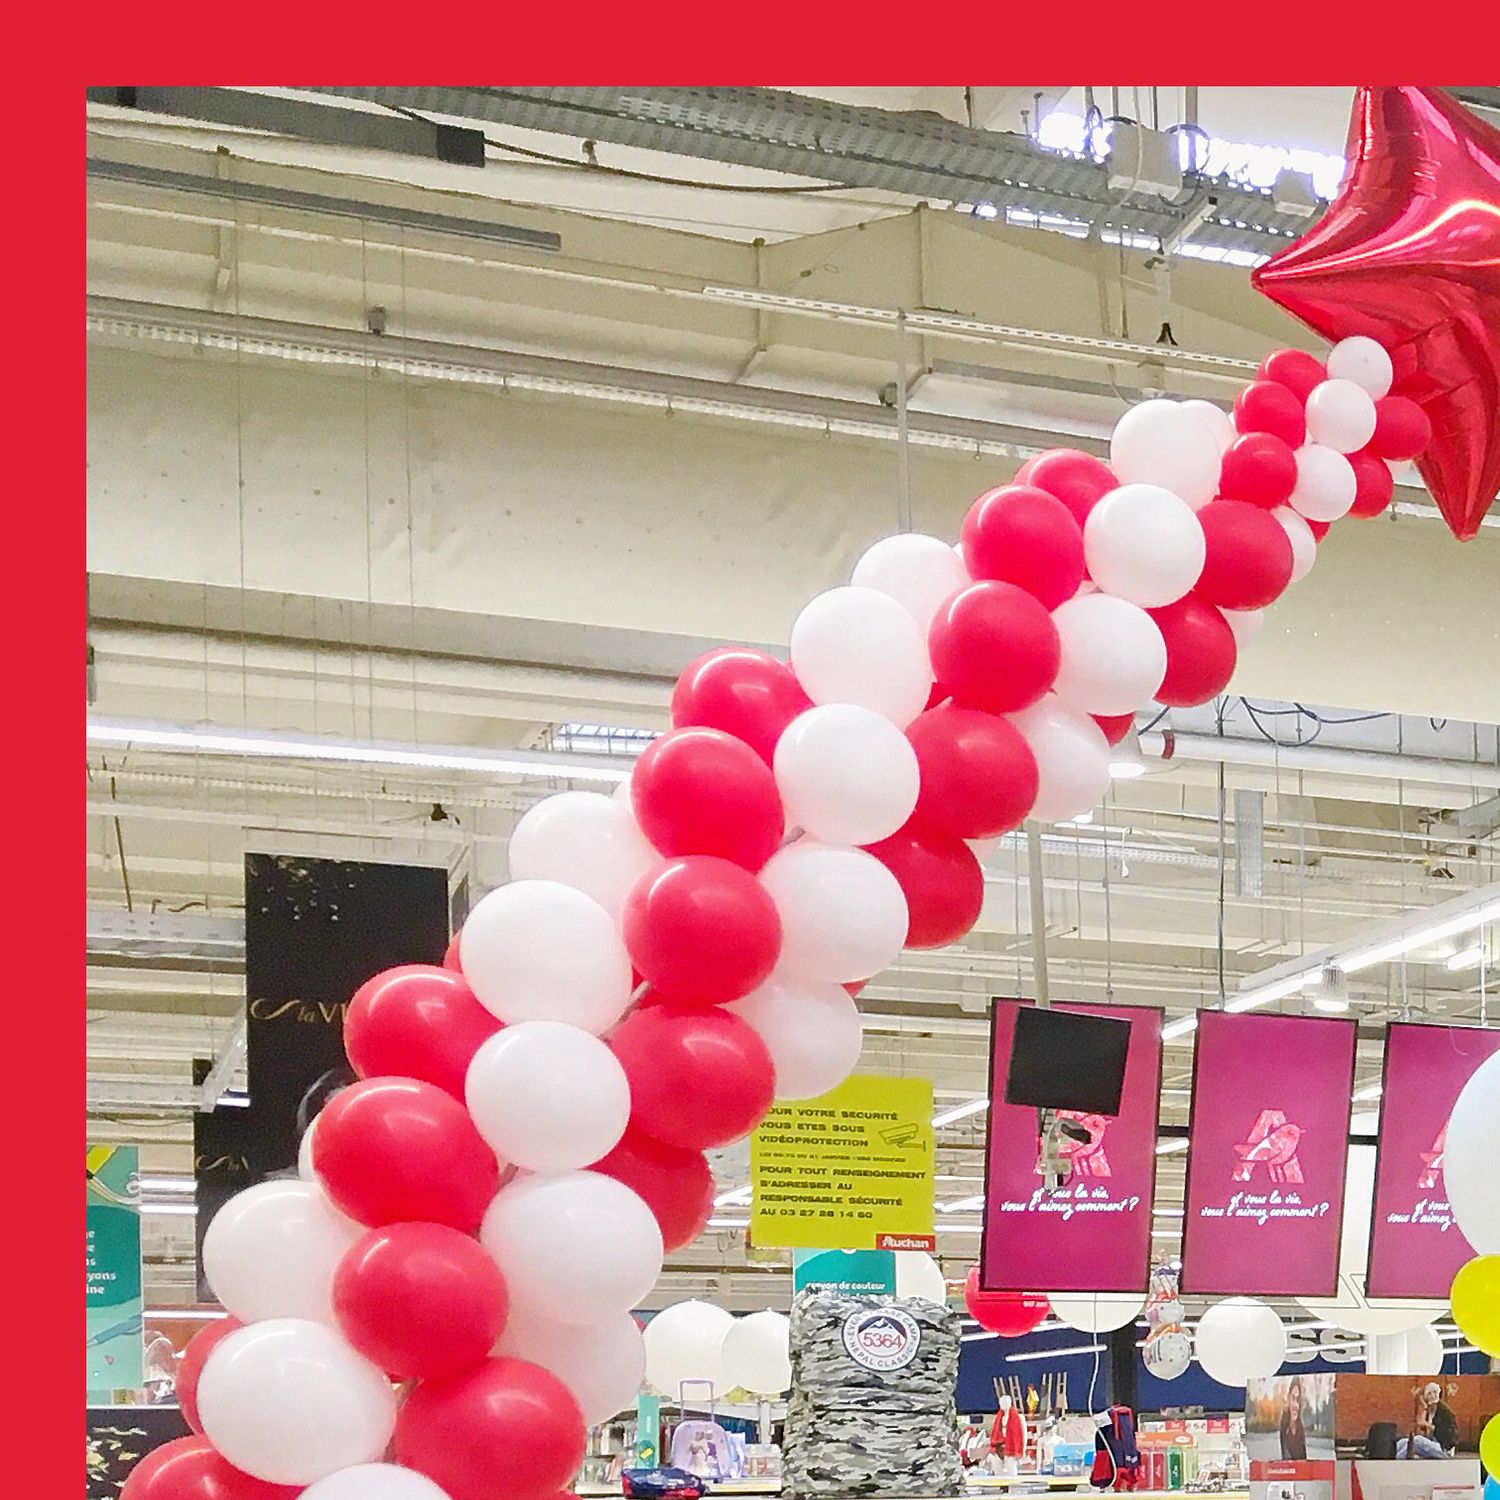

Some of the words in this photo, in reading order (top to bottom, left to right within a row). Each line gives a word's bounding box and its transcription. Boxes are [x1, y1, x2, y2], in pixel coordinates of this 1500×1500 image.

[764, 1108, 792, 1116] OUR
[797, 1109, 835, 1118] VOTRE
[759, 1122, 791, 1130] VOUS
[832, 1124, 864, 1133] SOUS
[759, 1166, 792, 1174] POUR
[798, 1167, 827, 1176] TOUT
[832, 1169, 926, 1179] RENSEIGNEMENT
[759, 1180, 832, 1189] S'ADRESSER
[760, 1194, 843, 1204] RESPONSABLE
[760, 1208, 776, 1216] AU
[882, 1236, 930, 1248] Auchan
[839, 1281, 850, 1290] de
[863, 1333, 902, 1349] 5364
